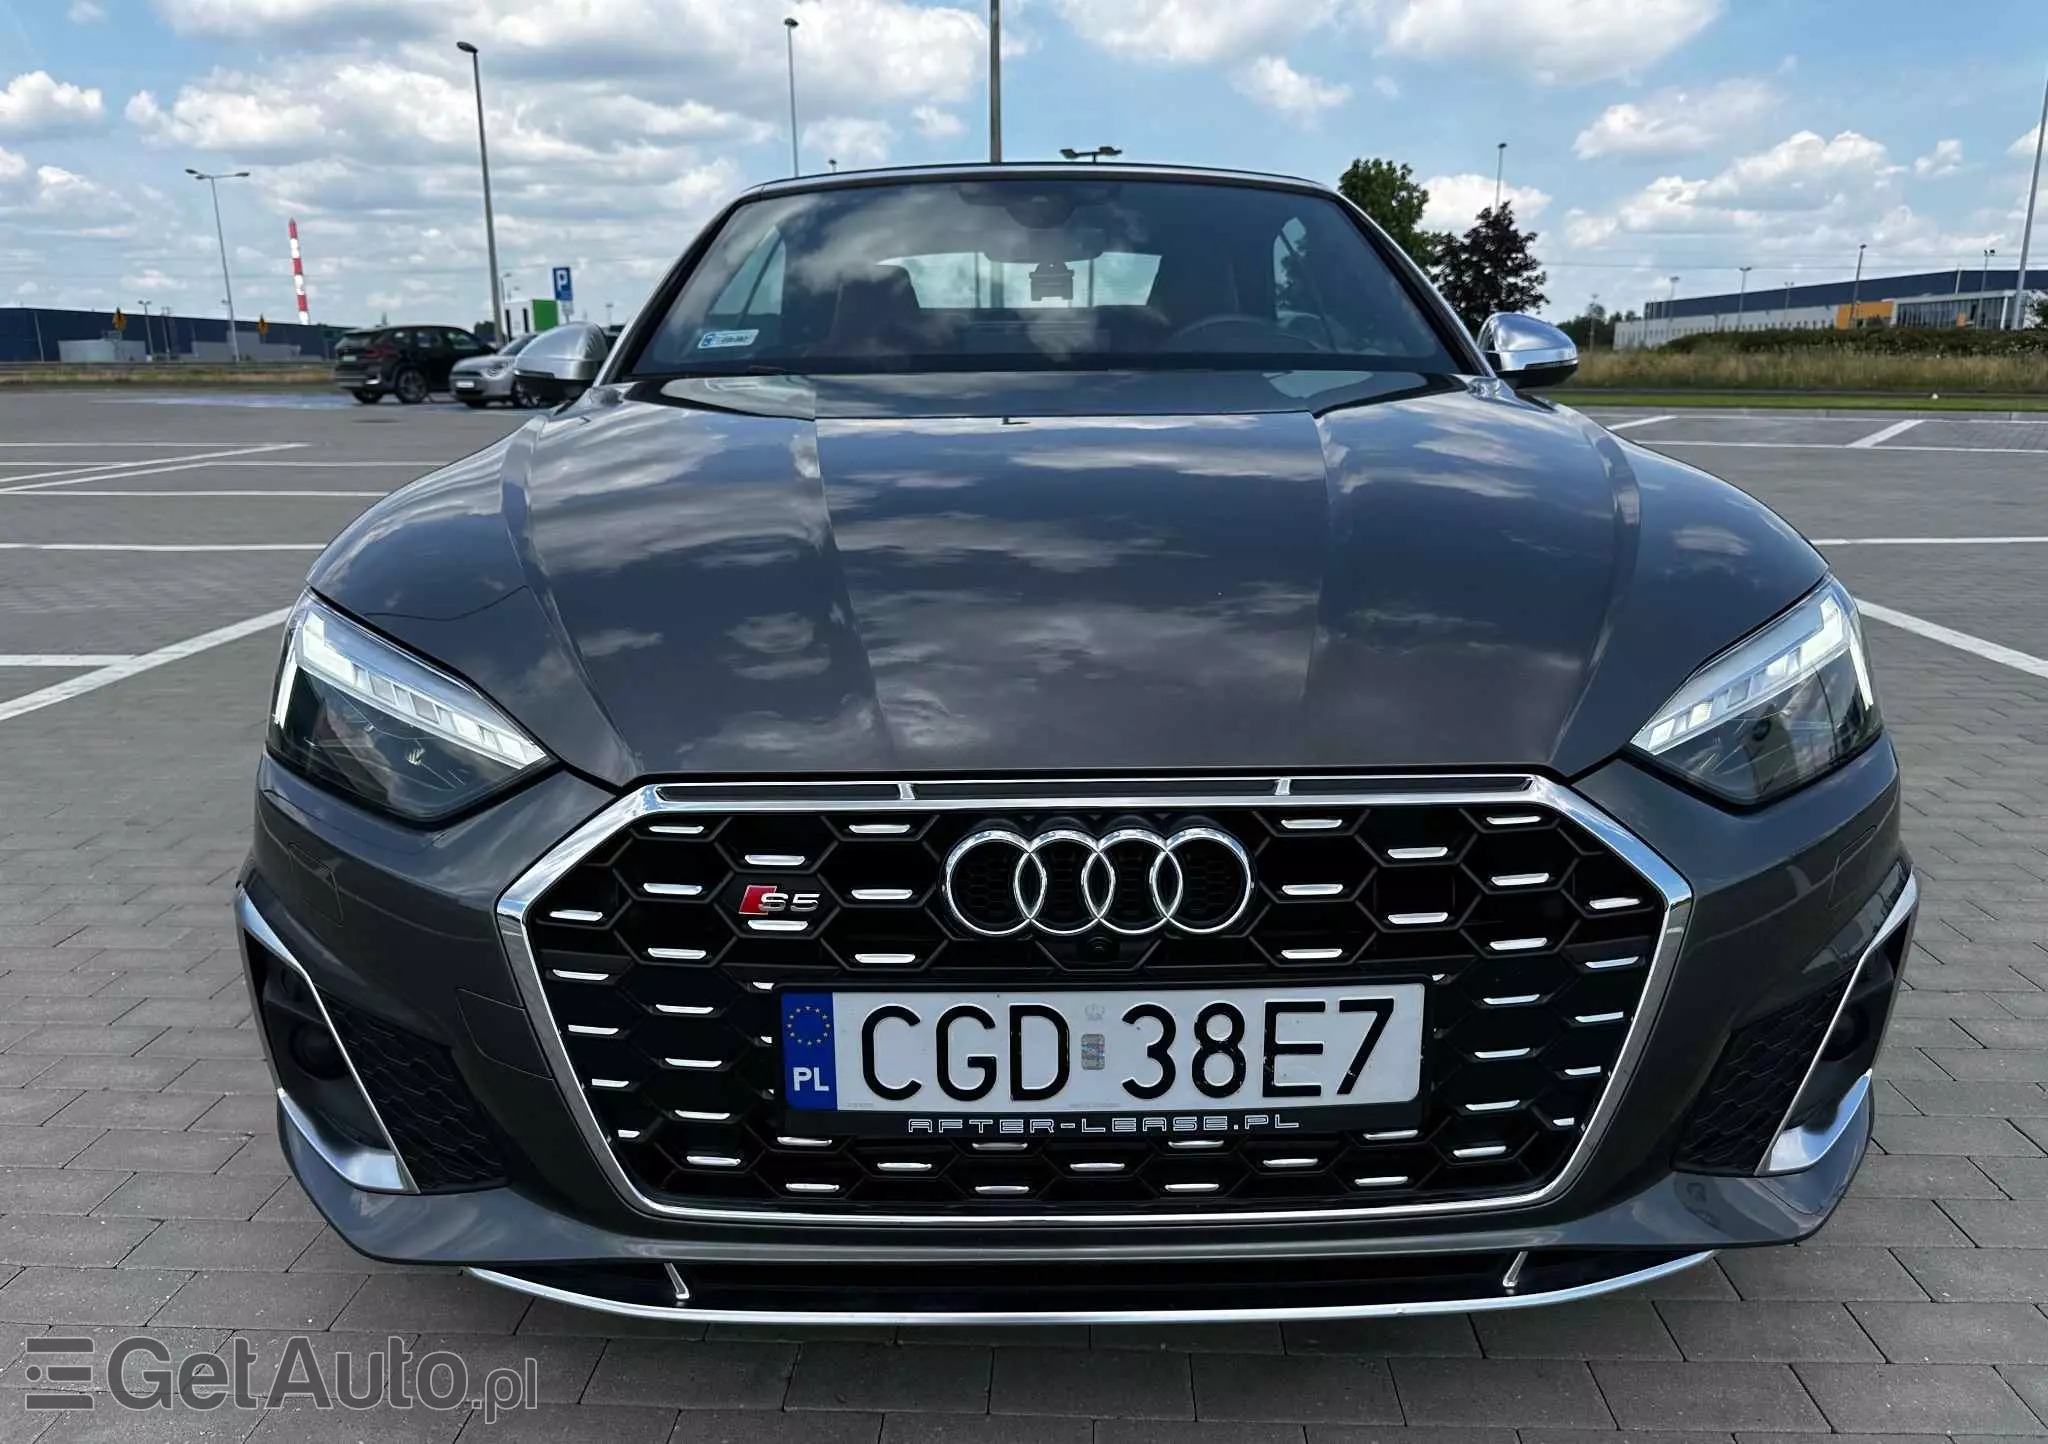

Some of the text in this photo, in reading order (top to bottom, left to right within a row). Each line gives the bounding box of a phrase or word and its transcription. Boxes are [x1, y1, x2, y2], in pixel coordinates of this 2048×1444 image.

[555, 270, 568, 291] P
[758, 893, 820, 912] S5
[861, 998, 1394, 1101] CGD 38E7
[792, 1067, 829, 1092] PL
[908, 1114, 1299, 1133] AFTER-LEASE.PL
